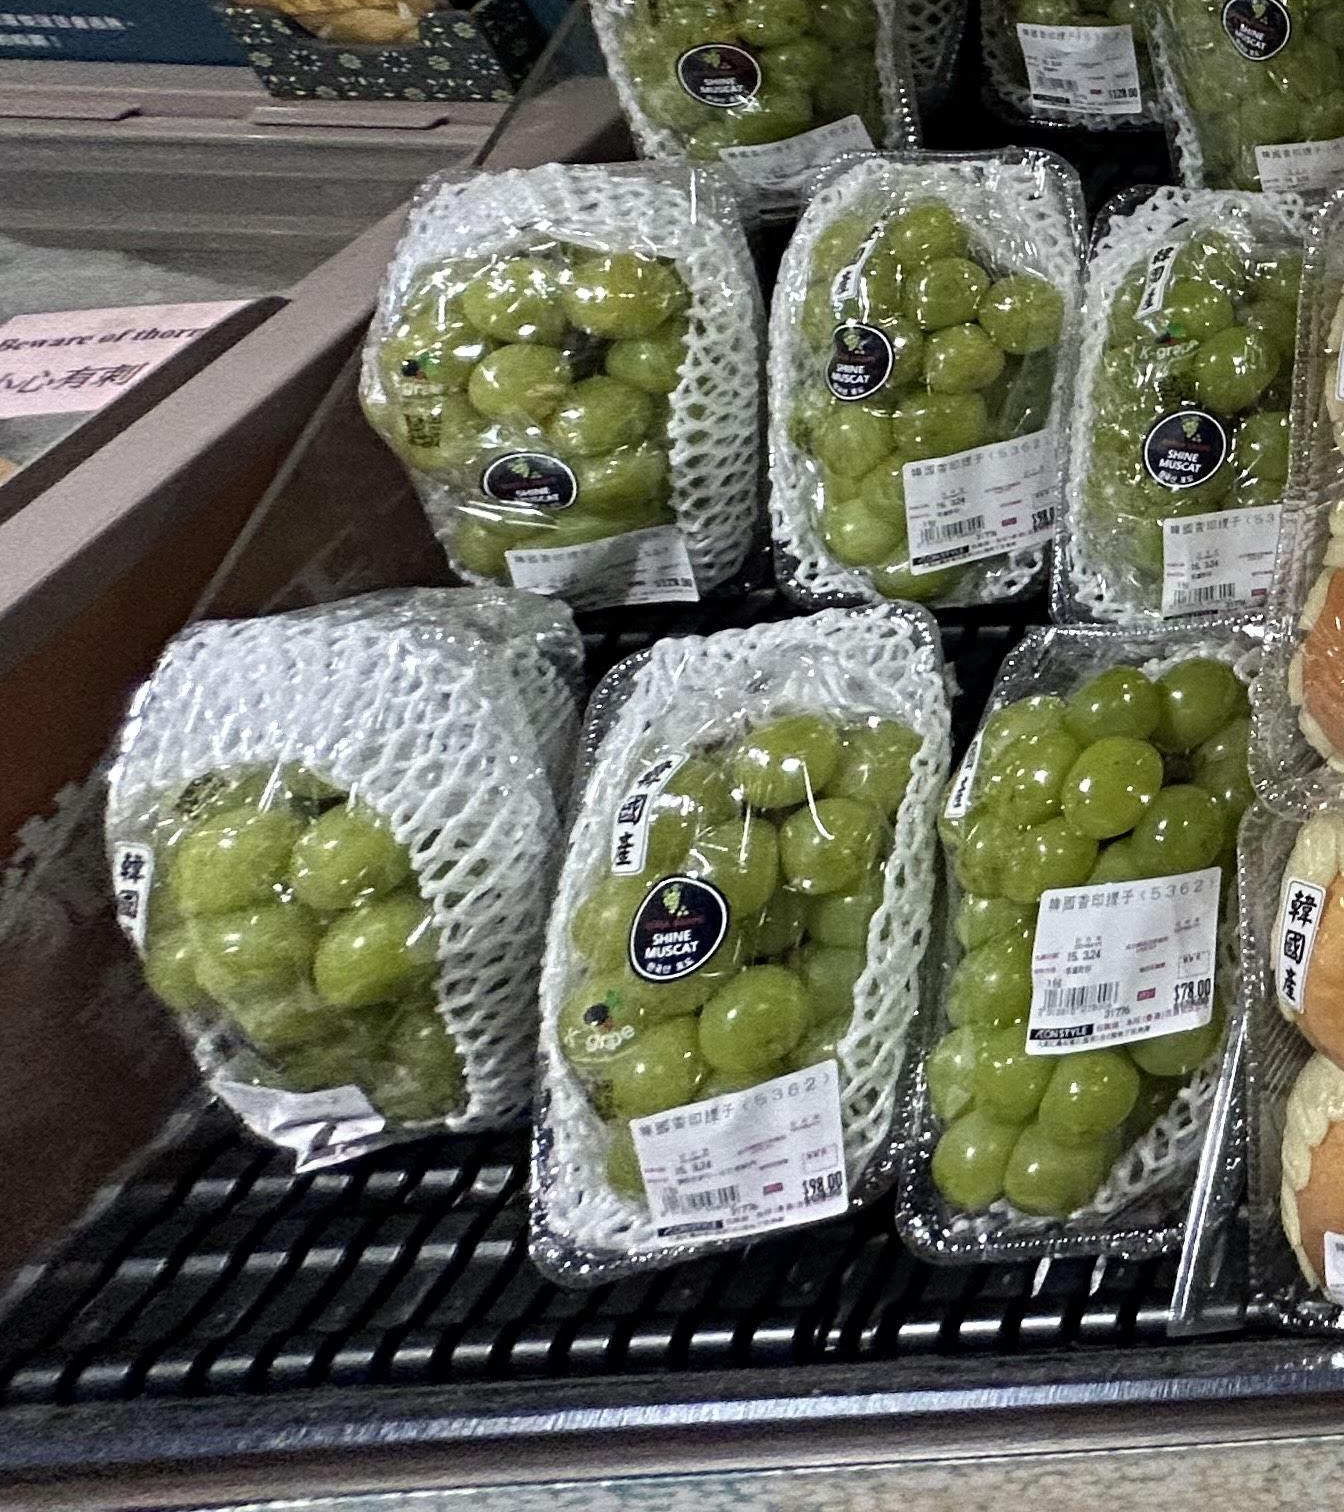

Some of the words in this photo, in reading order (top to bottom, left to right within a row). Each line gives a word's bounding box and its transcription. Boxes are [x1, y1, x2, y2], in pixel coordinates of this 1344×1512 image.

[98, 328, 131, 344] of
[837, 363, 865, 375] SHINE
[831, 372, 871, 385] MUSCAT
[1166, 449, 1200, 464] SHINE
[1159, 458, 1202, 474] MUSCAT
[652, 929, 693, 945] SHINE
[644, 940, 699, 961] MUSCAT
[1282, 890, 1319, 1002] 韓國產
[1174, 977, 1212, 1004] $78.00
